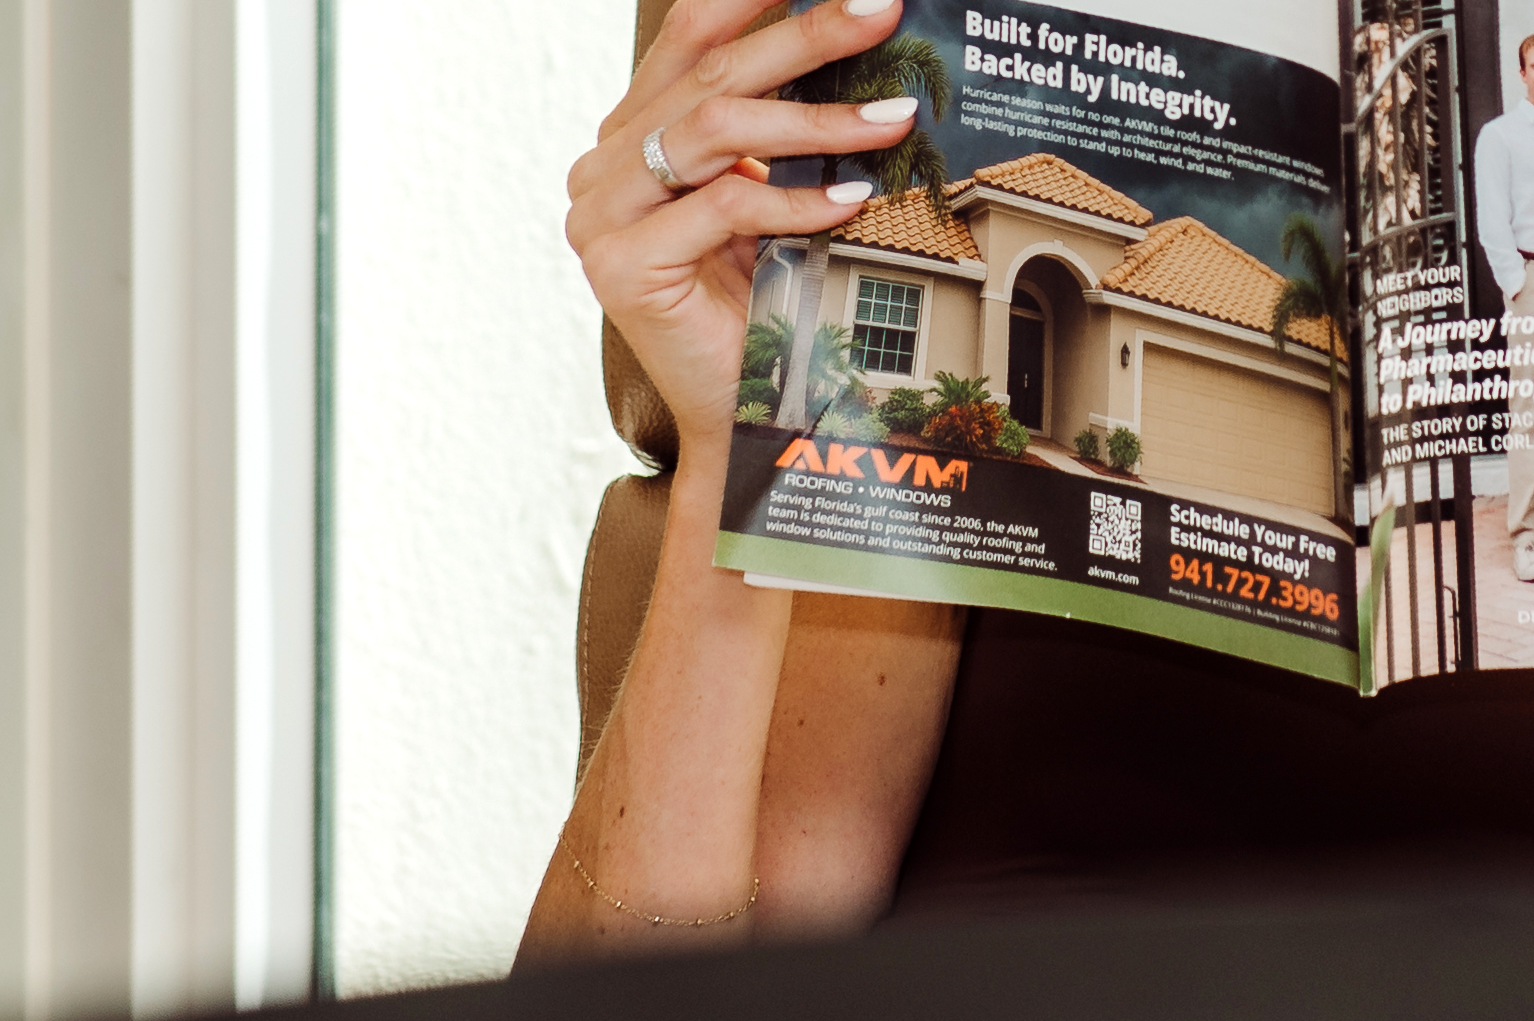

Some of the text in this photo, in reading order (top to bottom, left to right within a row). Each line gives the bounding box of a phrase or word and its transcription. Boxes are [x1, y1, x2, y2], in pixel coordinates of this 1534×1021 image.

[965, 9, 1186, 79] Built for Florida.
[964, 44, 1237, 130] Backed by Integrity.
[960, 113, 1235, 180] long-lasting protection to stand up to heat, wind, and water.
[961, 100, 1331, 194] combine hurricane resistance with architectural elegance. Premium materials deliver
[962, 84, 1325, 178] Hurricane season waits for no one. AKVM's tile roofs and impact-resistant windows
[1376, 265, 1461, 295] MEET YOUR
[1376, 286, 1464, 319] NEIGHBORS
[1377, 326, 1393, 355] A
[1396, 318, 1496, 349] Journey
[1380, 390, 1403, 415] to
[1381, 424, 1409, 445] THE
[1411, 416, 1463, 439] STORY
[1466, 414, 1488, 431] OF
[1381, 444, 1412, 467] AND
[1415, 437, 1488, 459] MICHAEL
[775, 437, 969, 492] AKVM
[770, 490, 1039, 539] Serving Florida's gulf coast since 2006, the AKVM
[784, 473, 952, 508] ROOFING WINDOWS
[765, 521, 1058, 571] window solutions and outstanding customer service.
[768, 506, 1045, 554] team is dedicated to providing quality roofing and
[1169, 504, 1337, 562] Schedule Your Free
[1170, 526, 1310, 580] Estimate Today!
[1088, 566, 1139, 586] akvm.com
[1168, 586, 1190, 600] Roofing
[1169, 553, 1339, 621] 941.727.3996
